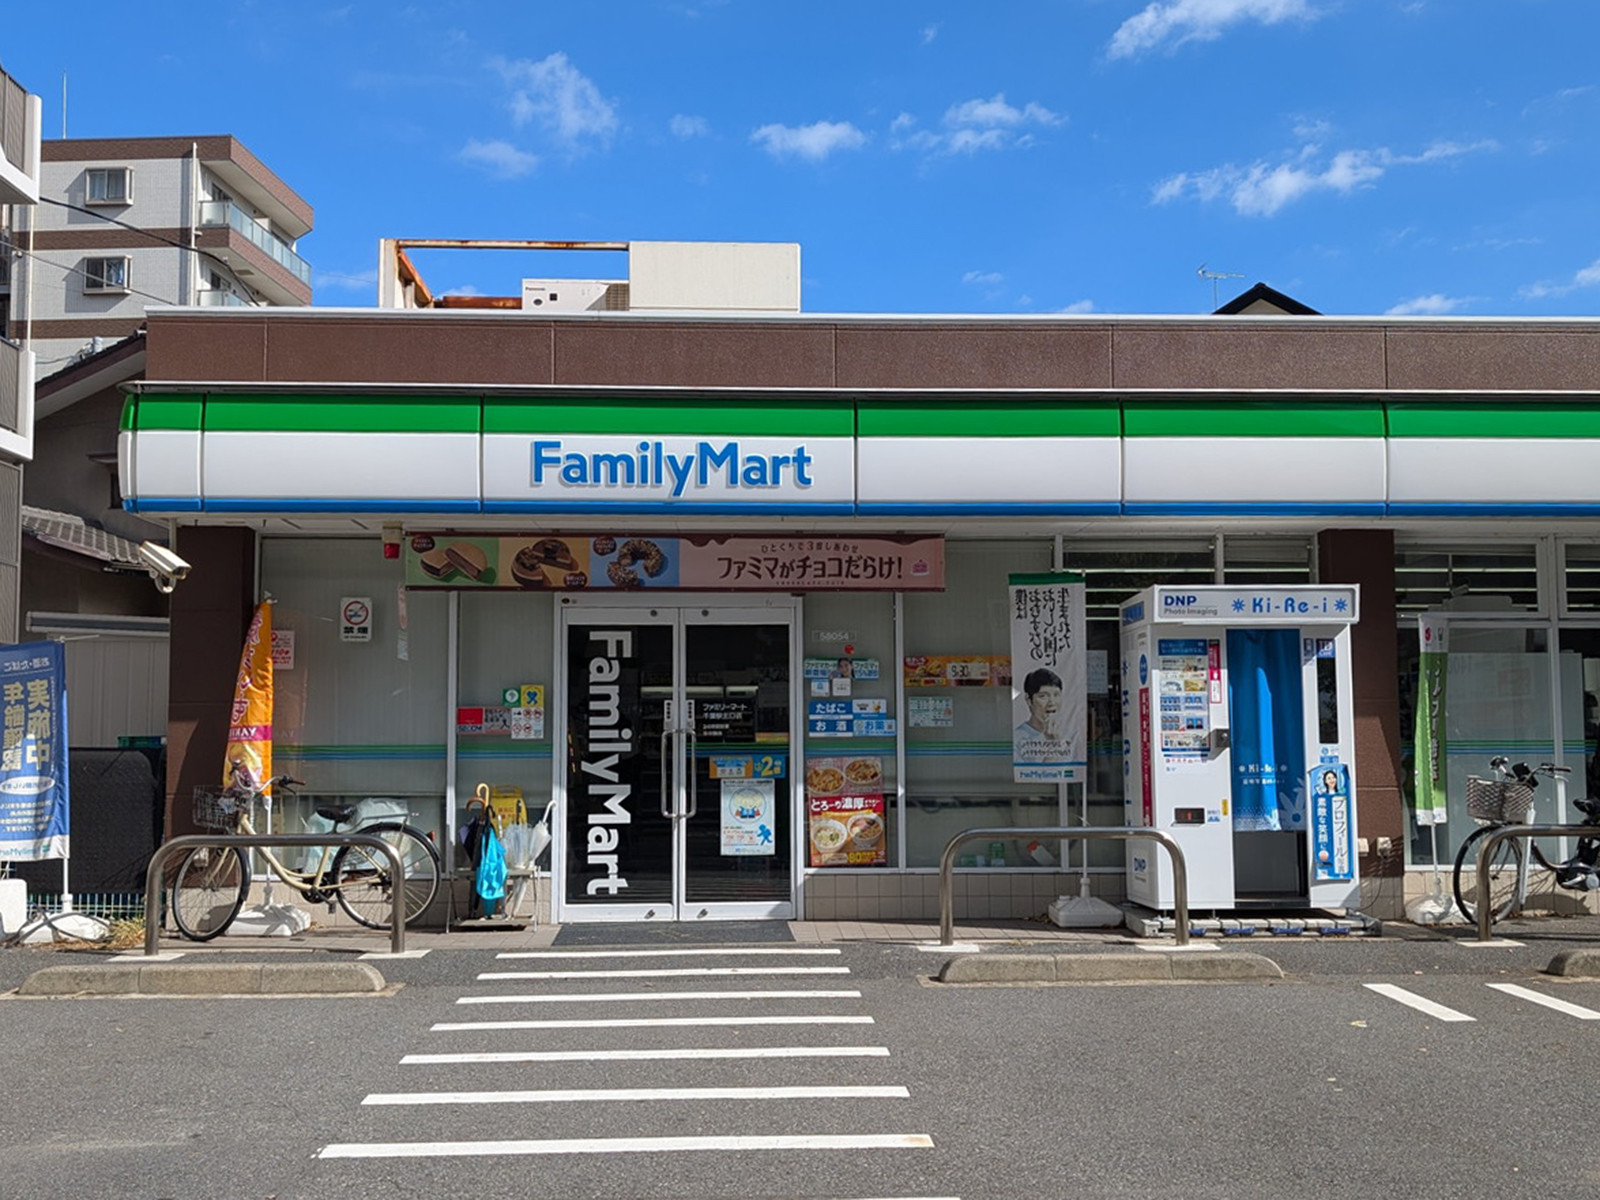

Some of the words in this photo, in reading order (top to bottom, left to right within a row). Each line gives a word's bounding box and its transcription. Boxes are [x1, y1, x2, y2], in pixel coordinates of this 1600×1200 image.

[532, 441, 812, 498] FamilyMart
[1164, 595, 1197, 606] DNP
[1252, 597, 1327, 613] Ki-Re-i
[1187, 608, 1218, 616] Imaging
[815, 703, 847, 714] たばこ
[581, 630, 633, 895] FamilyMart
